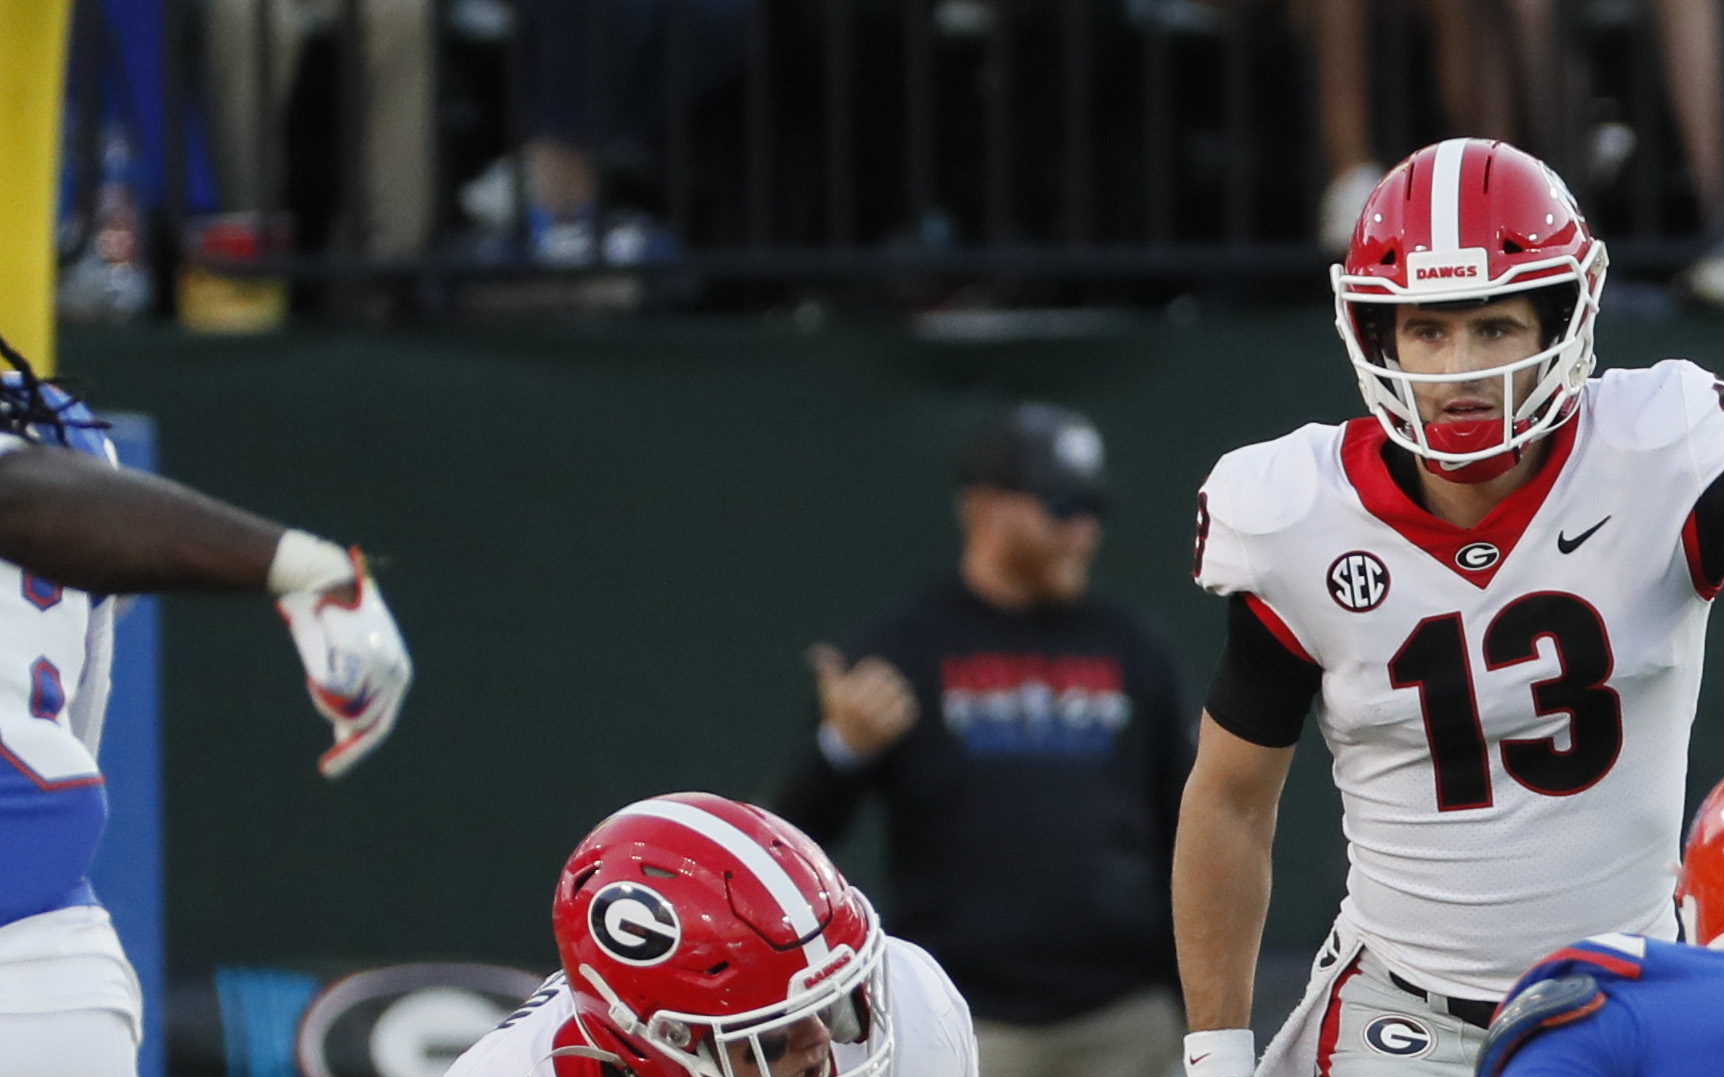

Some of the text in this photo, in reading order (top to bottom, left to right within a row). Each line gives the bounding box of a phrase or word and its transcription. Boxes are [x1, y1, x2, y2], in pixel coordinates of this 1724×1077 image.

[1416, 265, 1477, 280] DAWGS
[1460, 544, 1499, 568] G
[1331, 555, 1386, 609] SEC
[1387, 590, 1623, 812] 13
[596, 889, 680, 957] G
[1371, 1018, 1430, 1054] G
